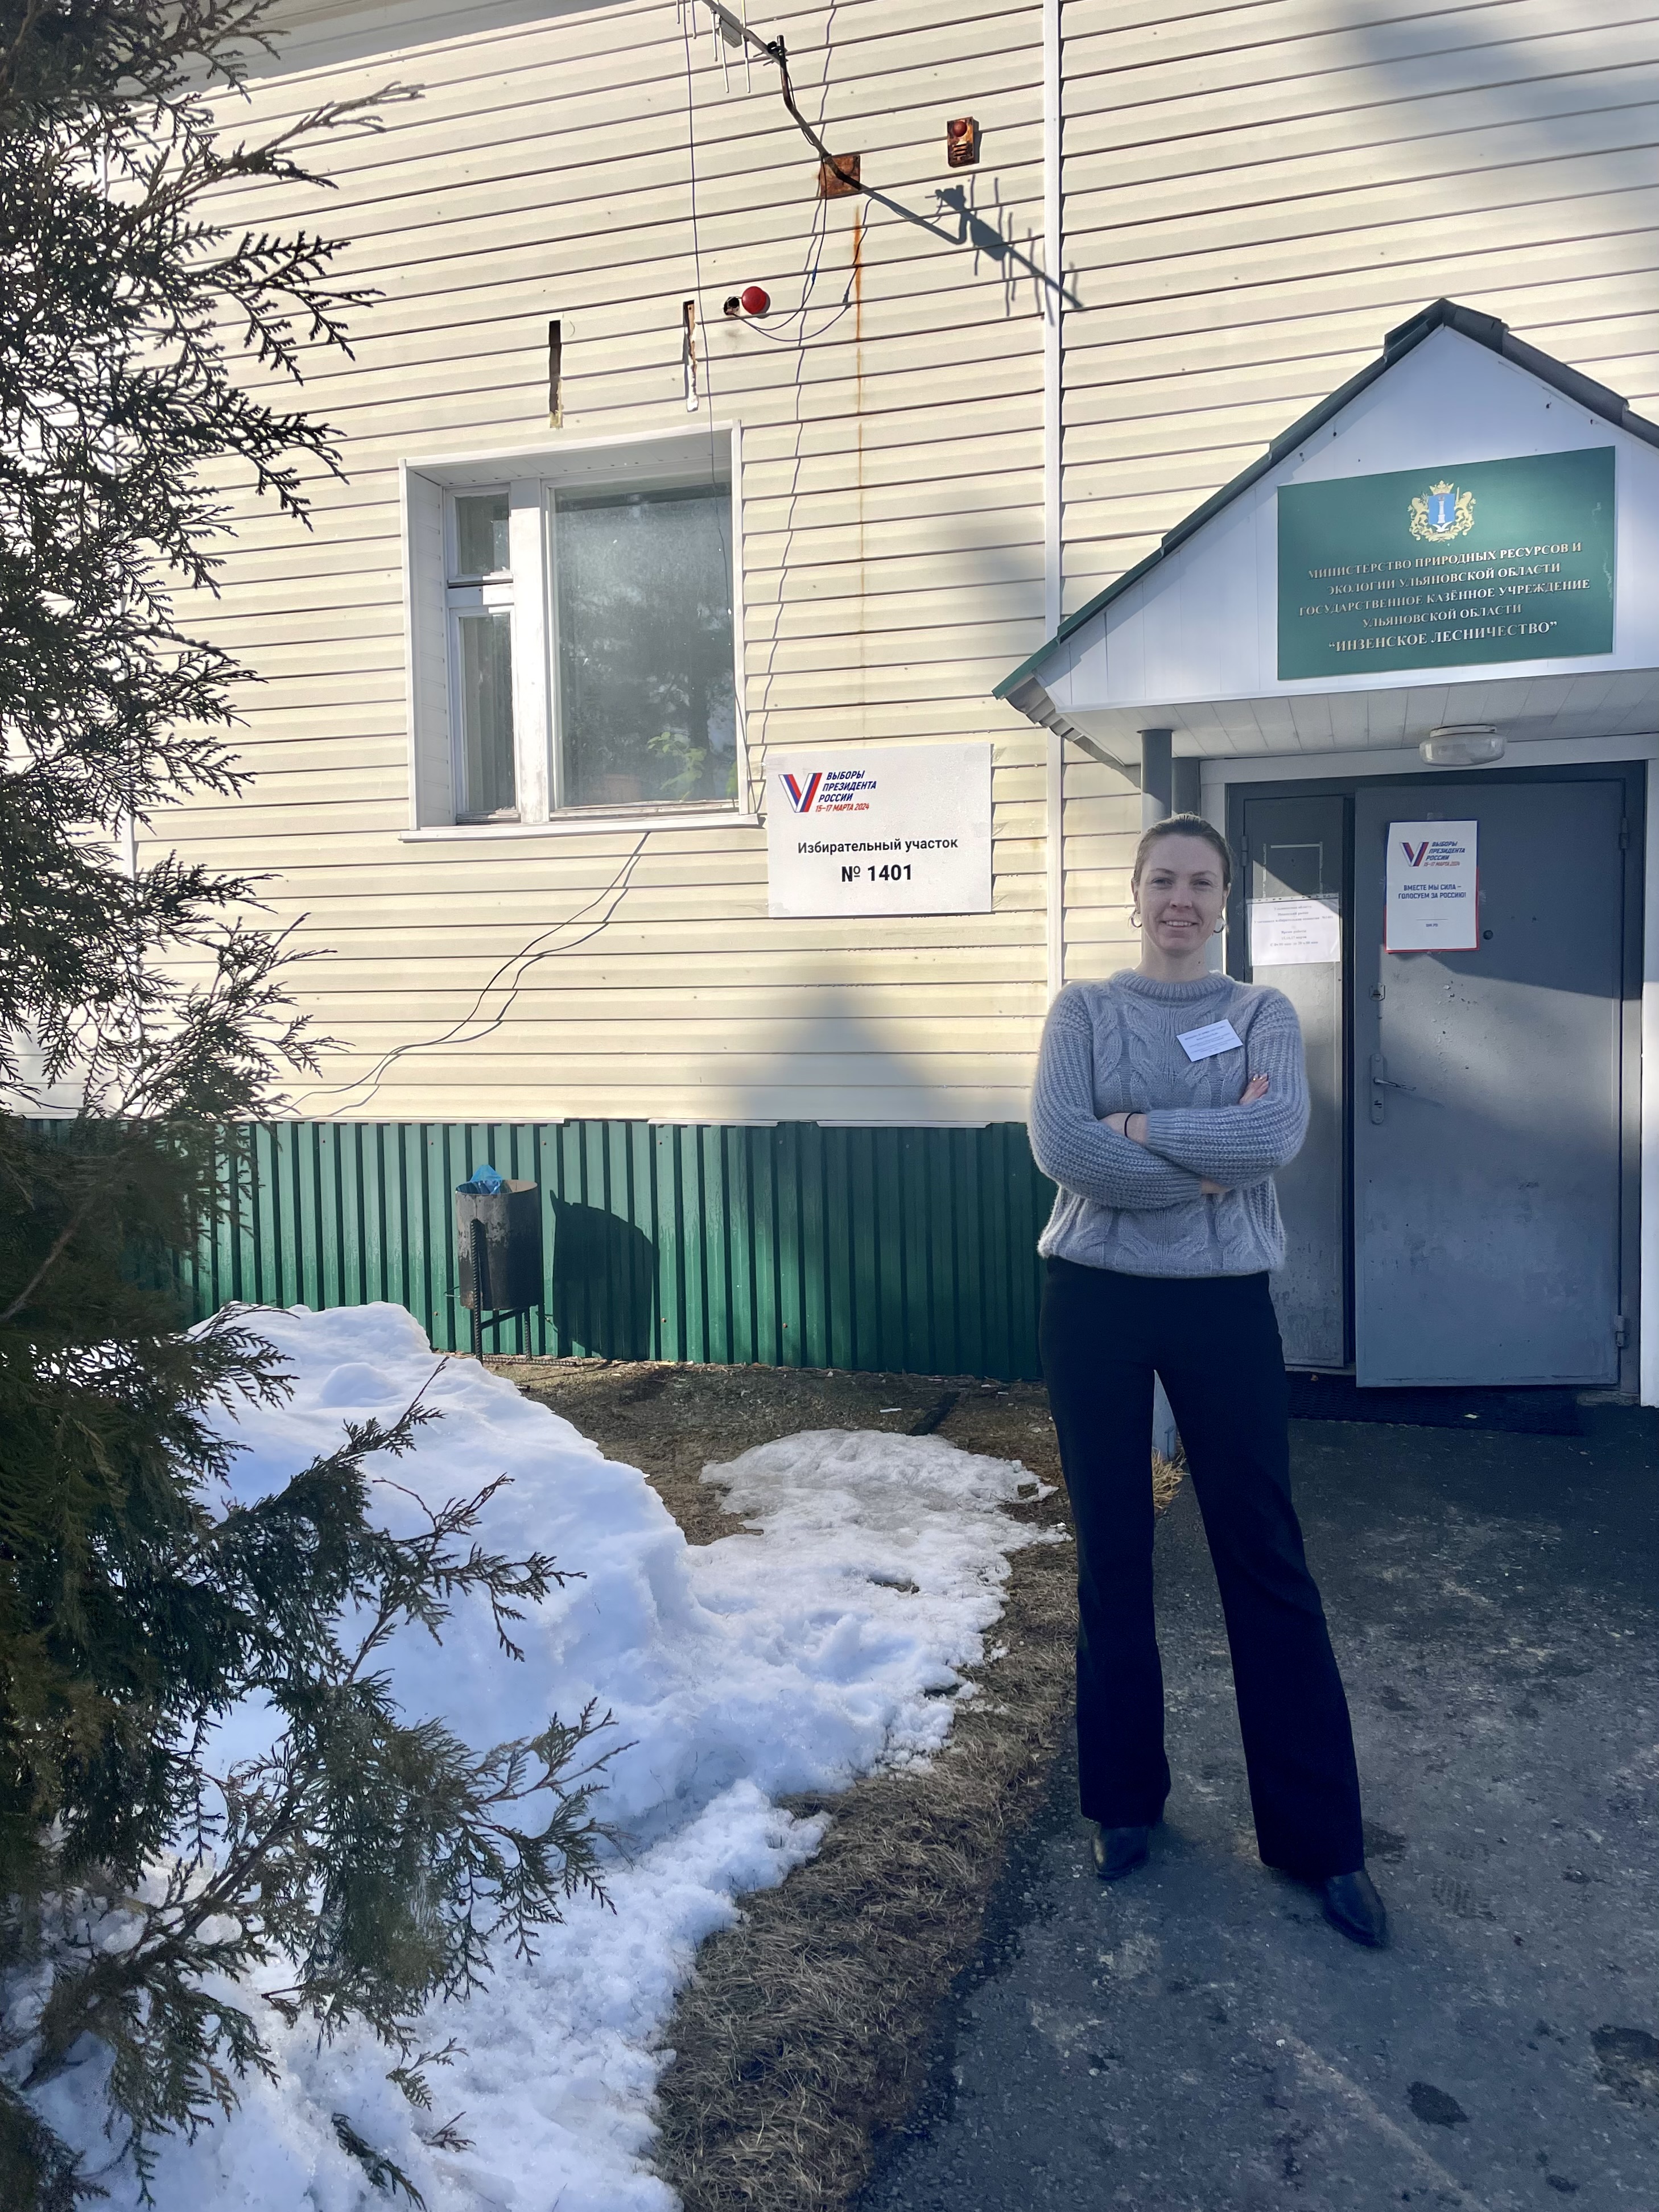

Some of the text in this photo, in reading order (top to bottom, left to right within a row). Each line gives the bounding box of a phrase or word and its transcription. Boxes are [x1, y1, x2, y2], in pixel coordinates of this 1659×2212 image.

[1308, 542, 1582, 579] МИНИСТЕРСТВО ПРИРОДНЫХ РЕСУРСОВ И
[1327, 563, 1561, 595] ЭКОЛОГИИ УЛЬЯНОВСКОЙ ОБЛАСТИ
[1299, 579, 1590, 616] ГОСУДАРСТВЕННОЕ КАЗЁННОЕ УЧРЕЖДЕНИЕ
[1363, 604, 1522, 628] УЛЬЯНОВСКОЙ ОБЛАСТИ
[826, 770, 865, 780] ВЫБОРЫ
[822, 781, 877, 791] ПРЕЗИДЕНТА
[818, 793, 853, 802] РОССИИ
[798, 838, 959, 855] Избирательный участок
[841, 864, 911, 882] № 1401
